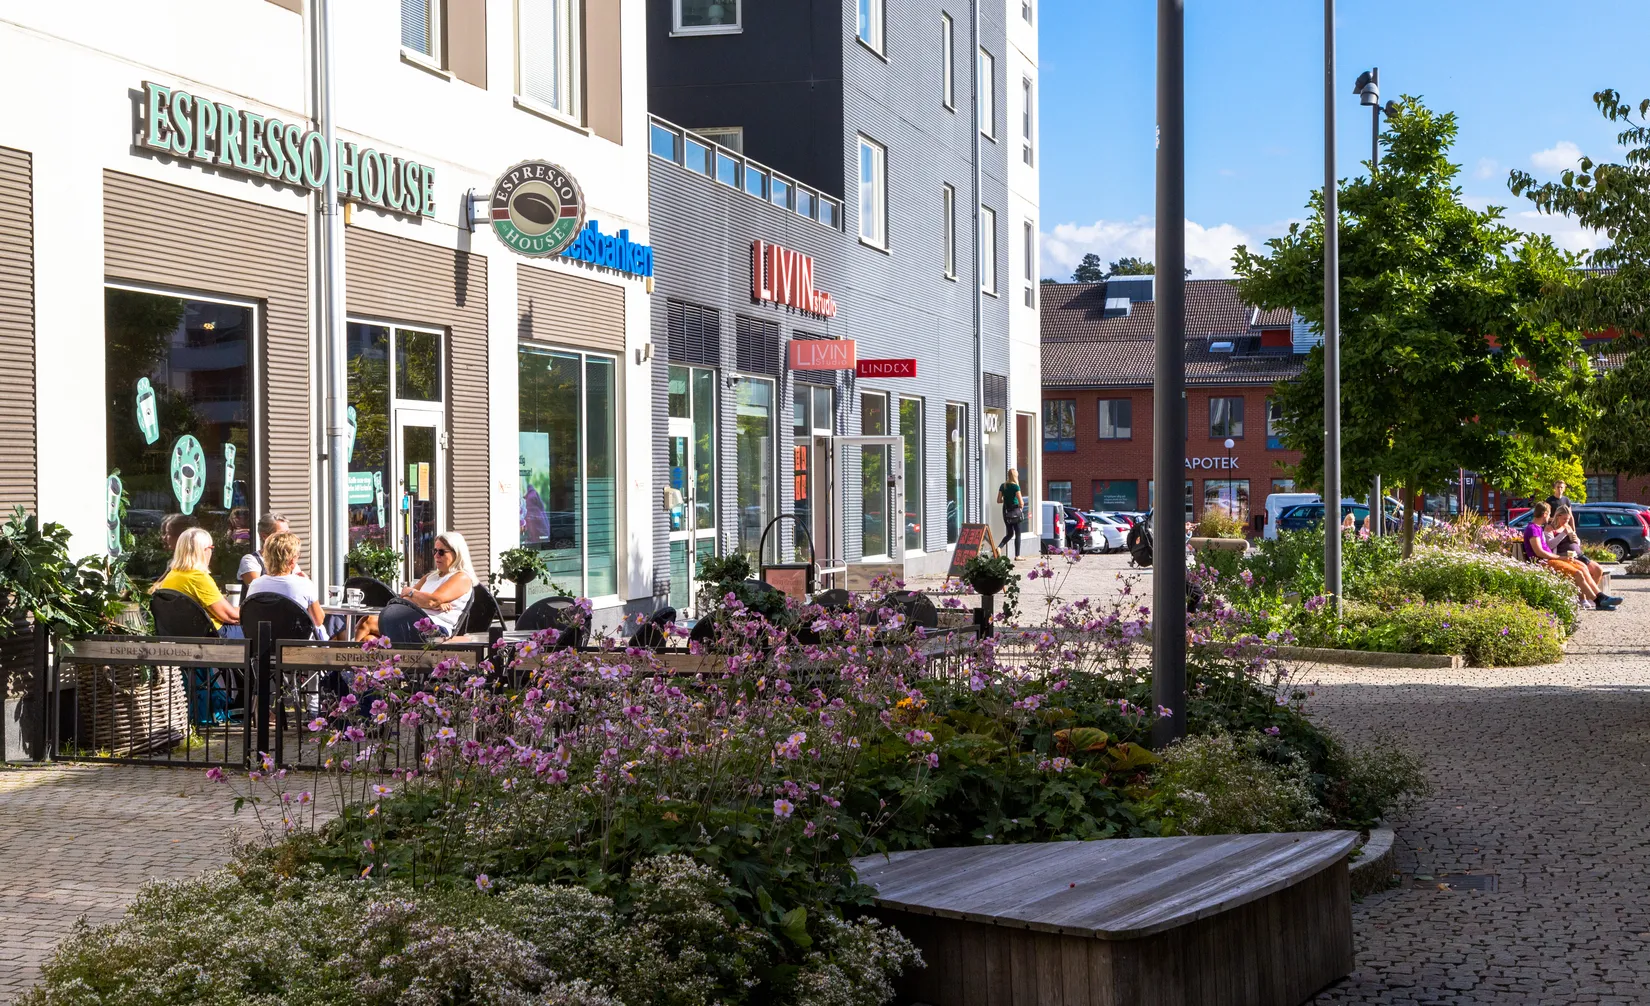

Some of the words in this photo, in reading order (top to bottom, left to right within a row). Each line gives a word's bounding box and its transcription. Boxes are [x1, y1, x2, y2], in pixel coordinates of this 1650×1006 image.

[142, 81, 330, 189] ESPRESSO
[336, 138, 436, 218] HOUSE
[496, 165, 573, 202] ESPRESSO
[504, 227, 565, 250] HOUSE
[753, 239, 814, 312] LIVIN
[796, 344, 848, 366] LIVIN
[861, 363, 910, 374] LINDEX
[1185, 456, 1240, 470] APOTEK
[110, 646, 156, 656] ESPRESSO
[158, 647, 193, 657] HOUSE
